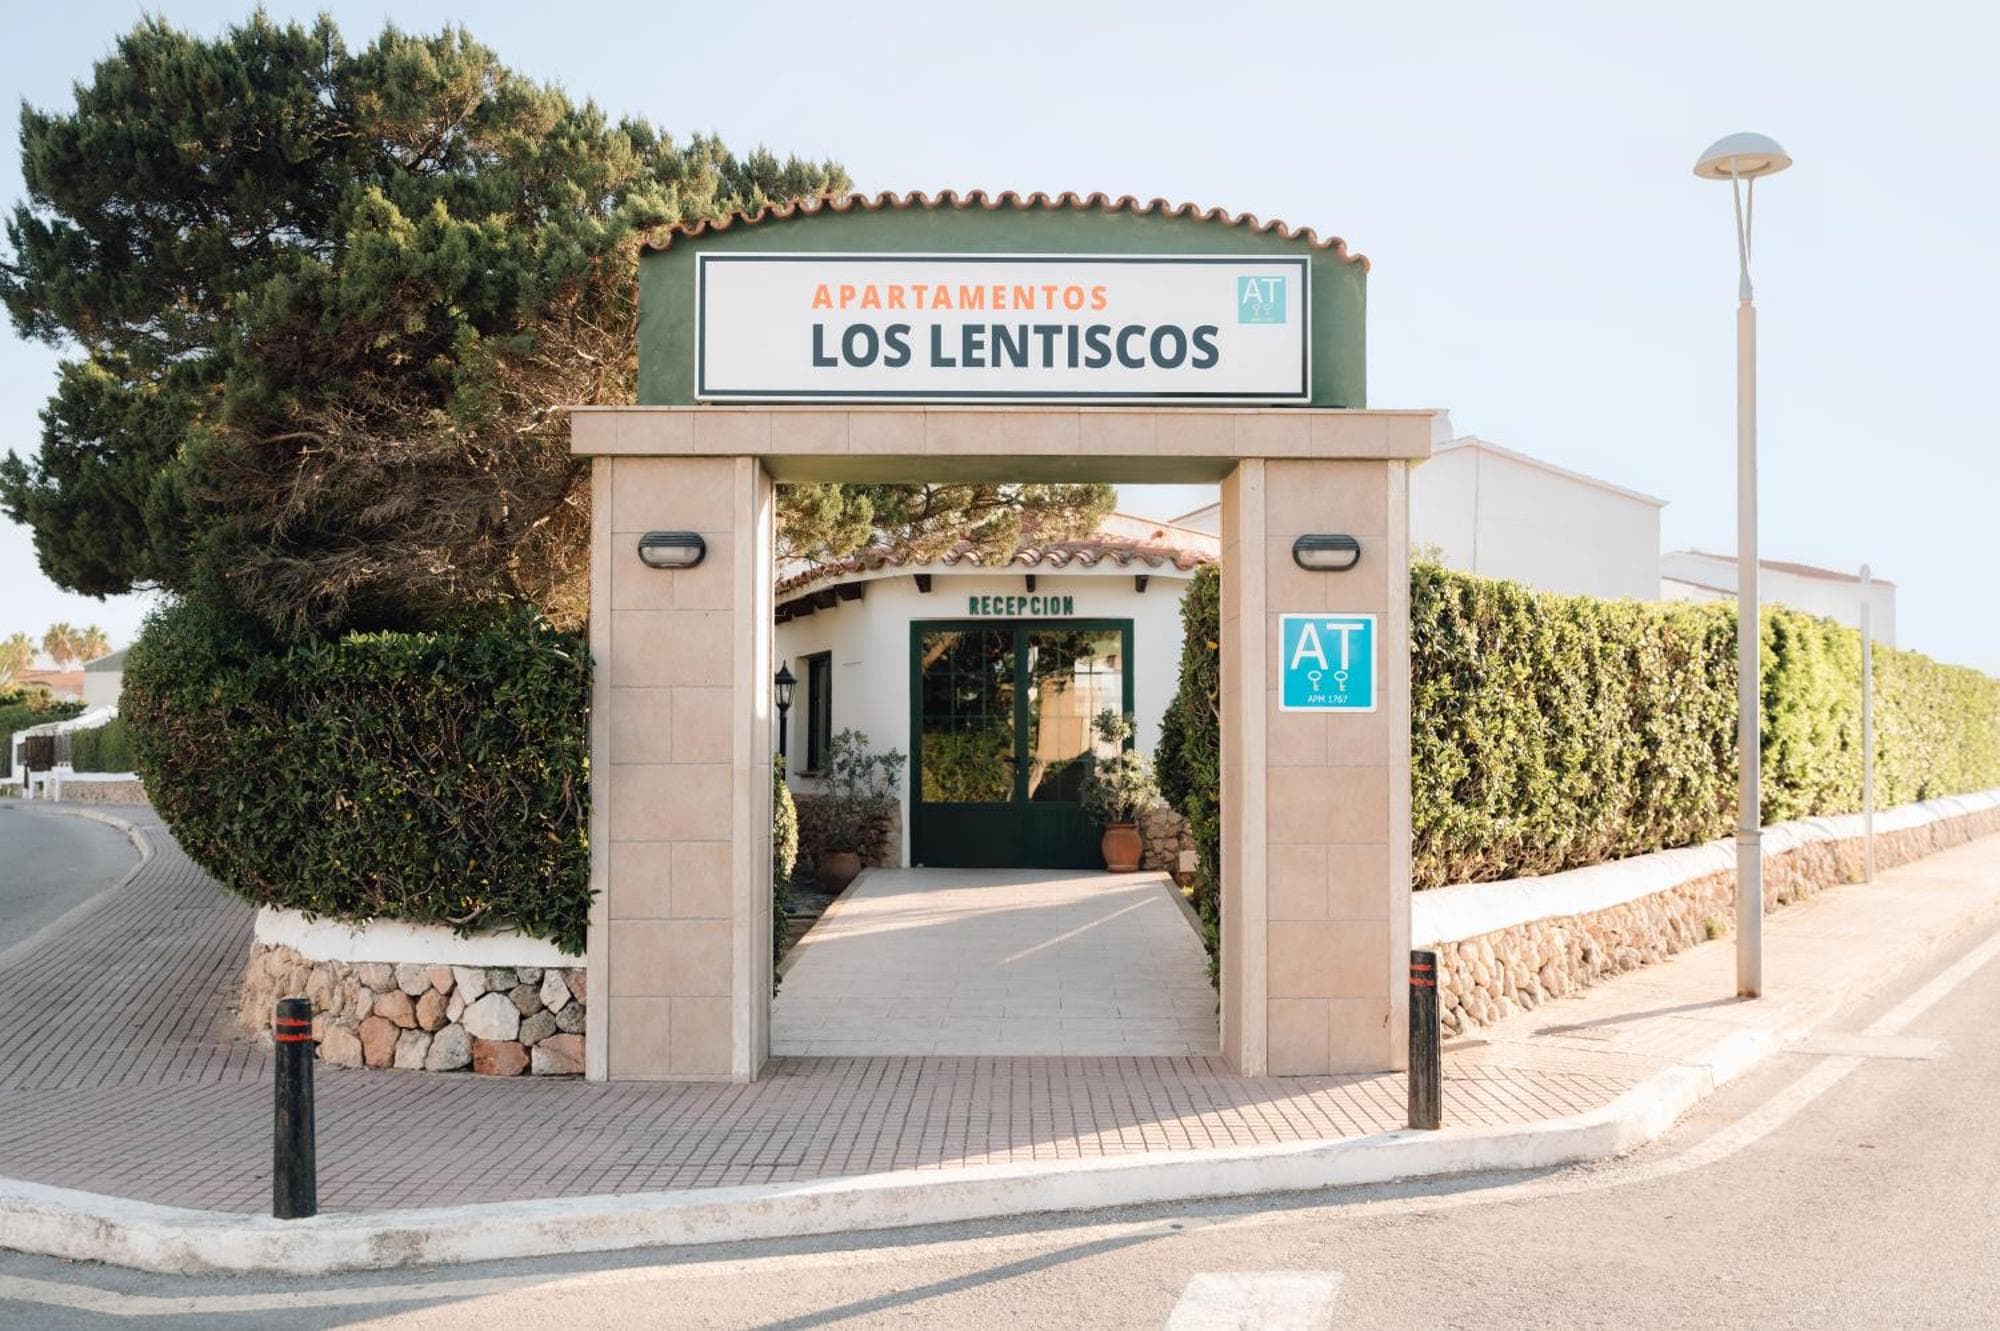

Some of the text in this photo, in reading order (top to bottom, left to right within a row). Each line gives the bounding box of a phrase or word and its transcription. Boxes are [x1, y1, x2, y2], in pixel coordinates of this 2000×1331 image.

[811, 283, 1108, 311] APARTAMENTOS
[1242, 278, 1282, 303] AT
[812, 323, 1220, 369] LOS LENTISCOS
[969, 595, 1073, 615] RECEPCION
[1290, 622, 1364, 670] AT
[1307, 695, 1325, 704] APM
